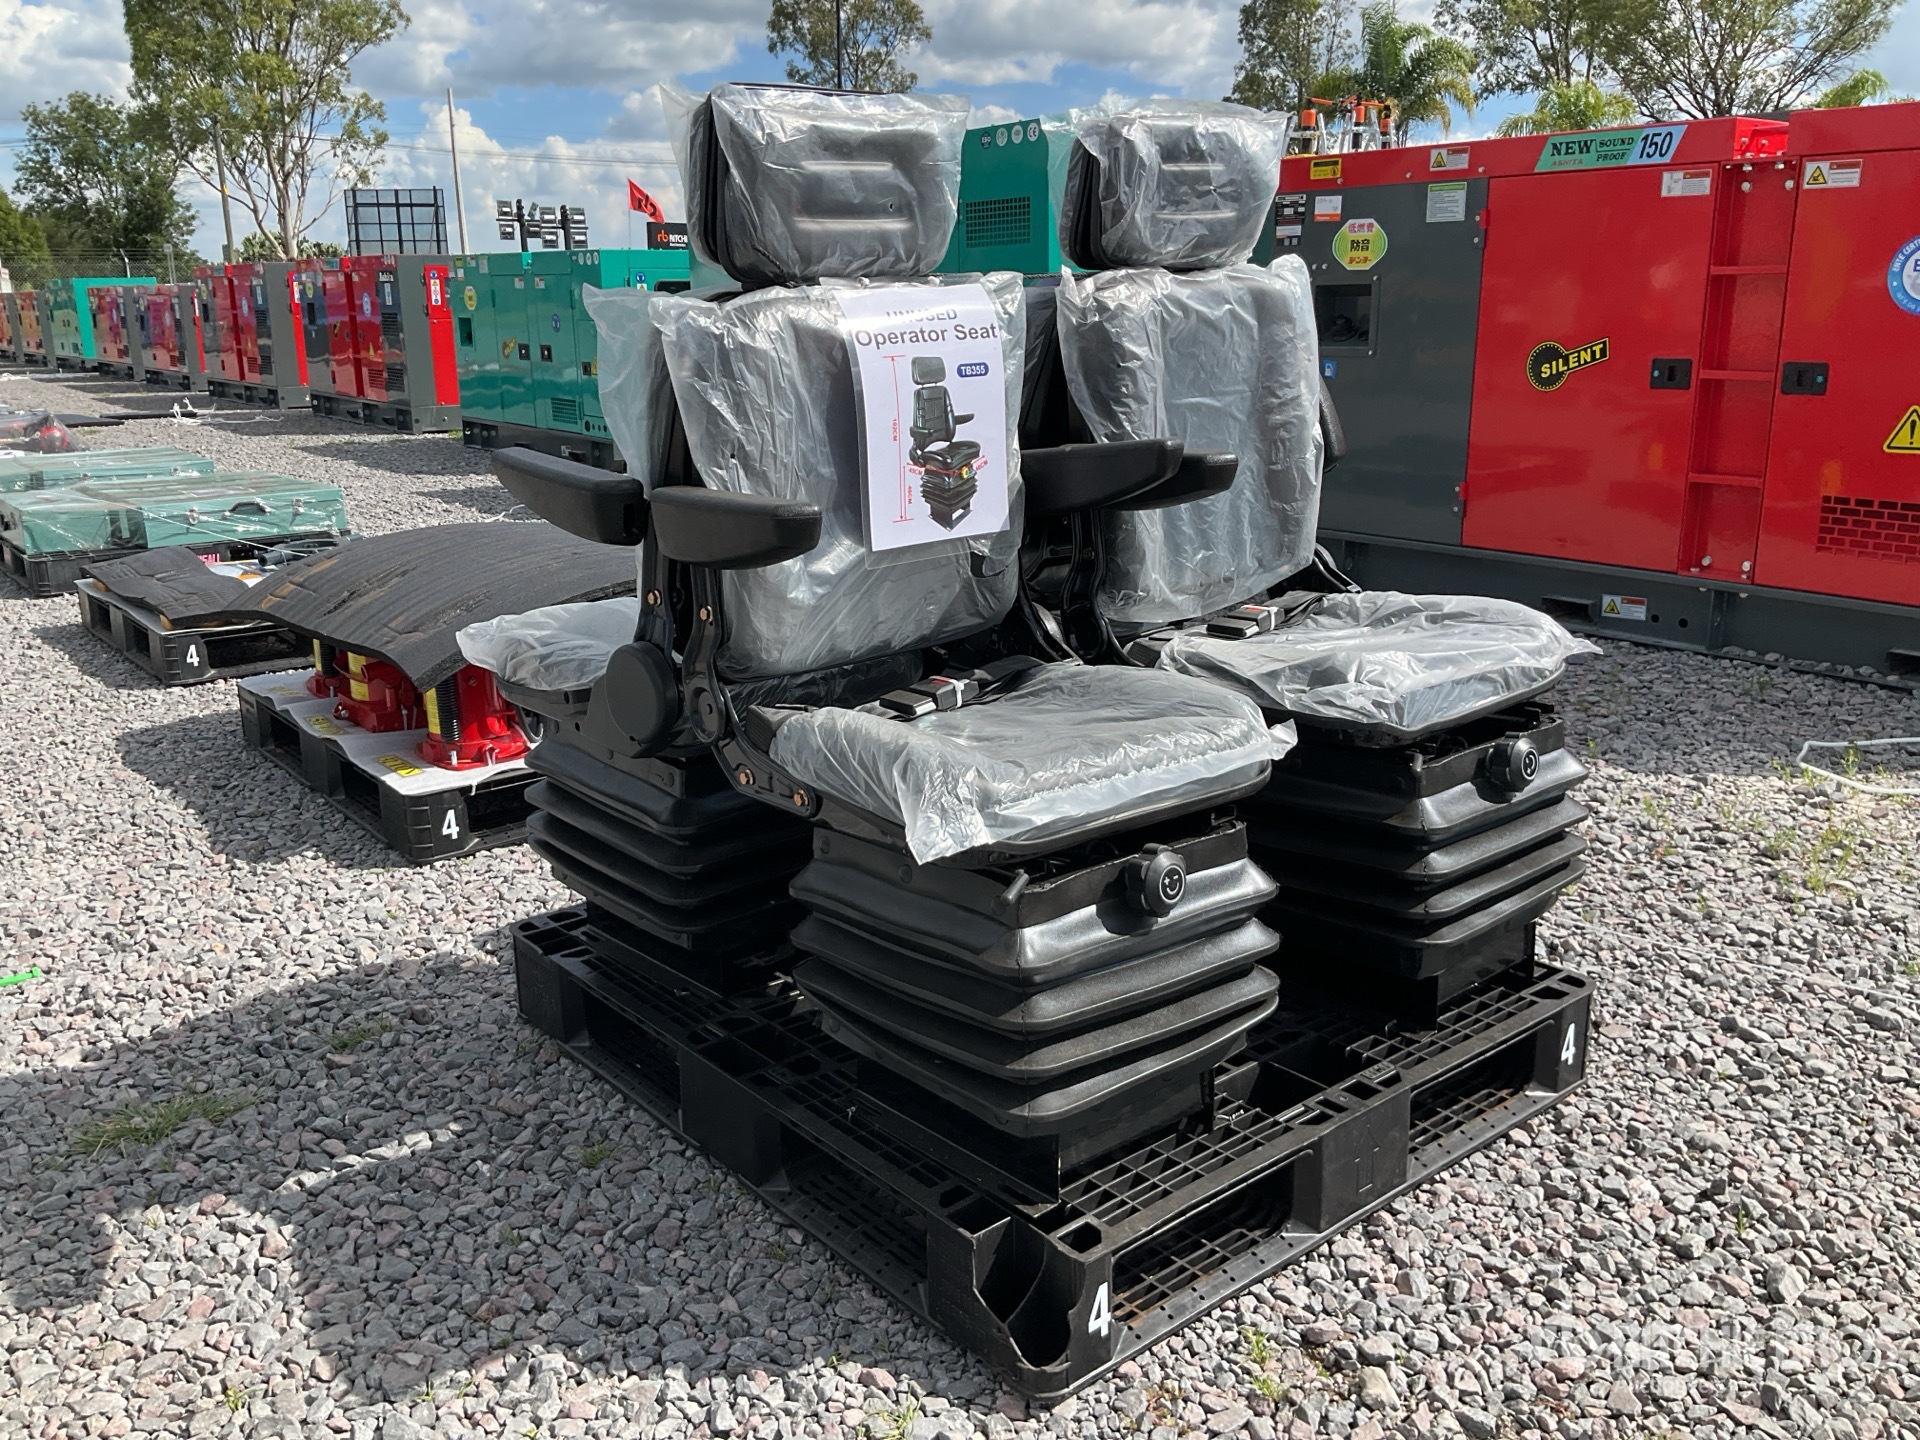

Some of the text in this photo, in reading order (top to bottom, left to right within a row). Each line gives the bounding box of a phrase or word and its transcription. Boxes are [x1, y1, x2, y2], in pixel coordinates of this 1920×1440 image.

[1550, 136, 1634, 157] NEW SOUND
[1597, 152, 1627, 162] PROOF
[1639, 131, 1674, 160] 150
[657, 230, 688, 243] rb RITCHI
[1350, 239, 1370, 252] 防音
[885, 308, 957, 323] SED
[855, 323, 998, 350] Operator Seat
[961, 365, 986, 376] TB355
[1540, 343, 1604, 378] SILENT
[185, 644, 200, 667] 4
[442, 809, 460, 840] 4
[1561, 1022, 1576, 1066] 4
[1088, 1281, 1112, 1338] 4
